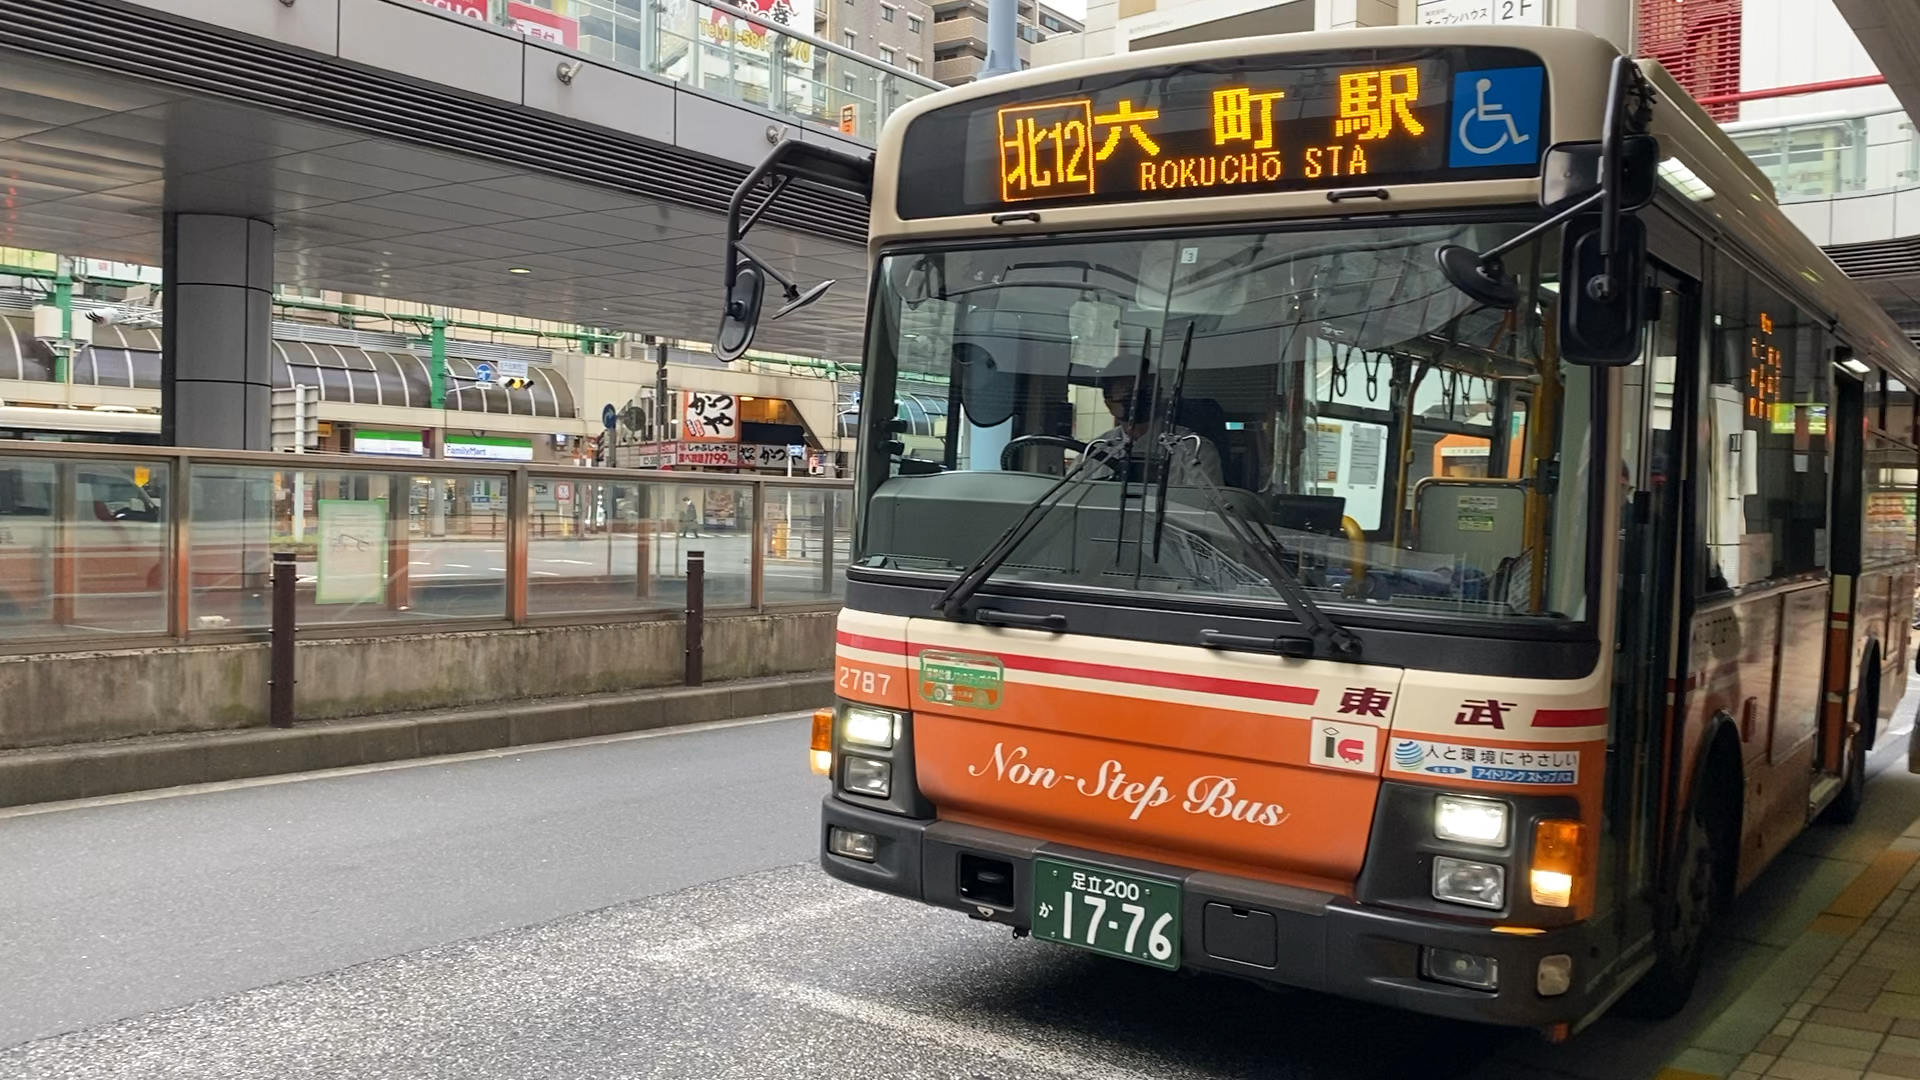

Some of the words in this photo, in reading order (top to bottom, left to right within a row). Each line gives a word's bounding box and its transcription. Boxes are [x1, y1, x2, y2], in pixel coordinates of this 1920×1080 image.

[1006, 116, 1088, 191] 北12
[1305, 144, 1368, 179] STA
[839, 665, 892, 696] 2787
[1425, 744, 1577, 768] 人と環境にやさしい
[968, 743, 1177, 821] Non-Step
[1182, 775, 1292, 826] Bus
[1038, 901, 1054, 918] か
[1062, 891, 1174, 961] 17-76
